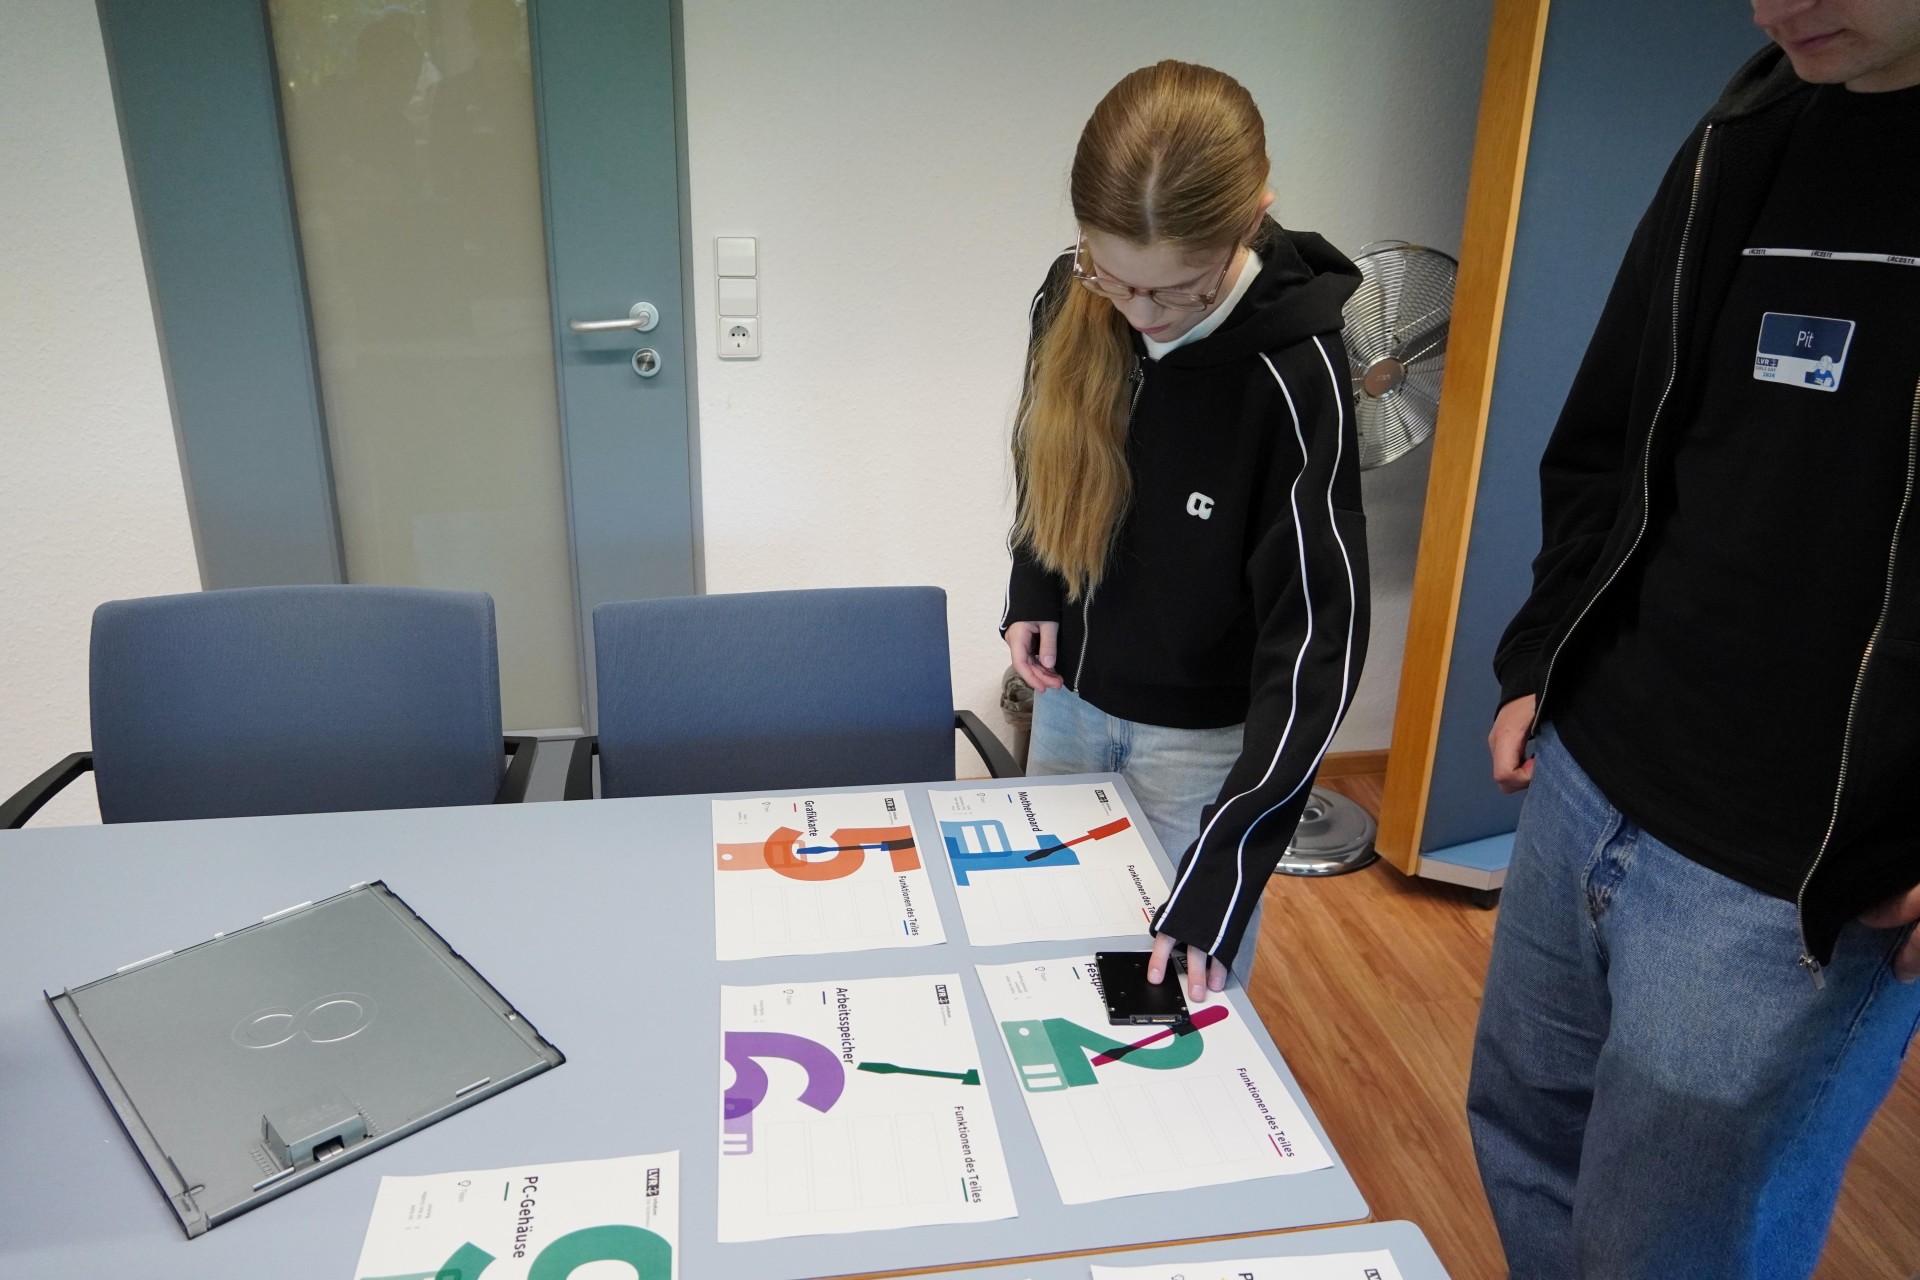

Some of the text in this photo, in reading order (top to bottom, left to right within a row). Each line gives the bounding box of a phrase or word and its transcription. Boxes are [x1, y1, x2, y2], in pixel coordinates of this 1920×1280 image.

[1811, 250, 1833, 258] LACOSTE
[1887, 255, 1915, 265] LACOSTE
[1796, 330, 1814, 348] Pit
[1757, 358, 1770, 366] LVR
[804, 800, 819, 837] Grafikkarte
[1018, 791, 1043, 832] Motherboard
[898, 875, 920, 936] Funktionen des Teiles
[1127, 864, 1147, 896] Funktionen
[1142, 895, 1152, 906] des
[836, 987, 856, 1065] Arbeitsspeicher
[1236, 1067, 1295, 1158] Funktionen des Teiles
[954, 1105, 983, 1204] Funktionen des Teiles
[512, 1176, 539, 1259] PC-Gehäuse
